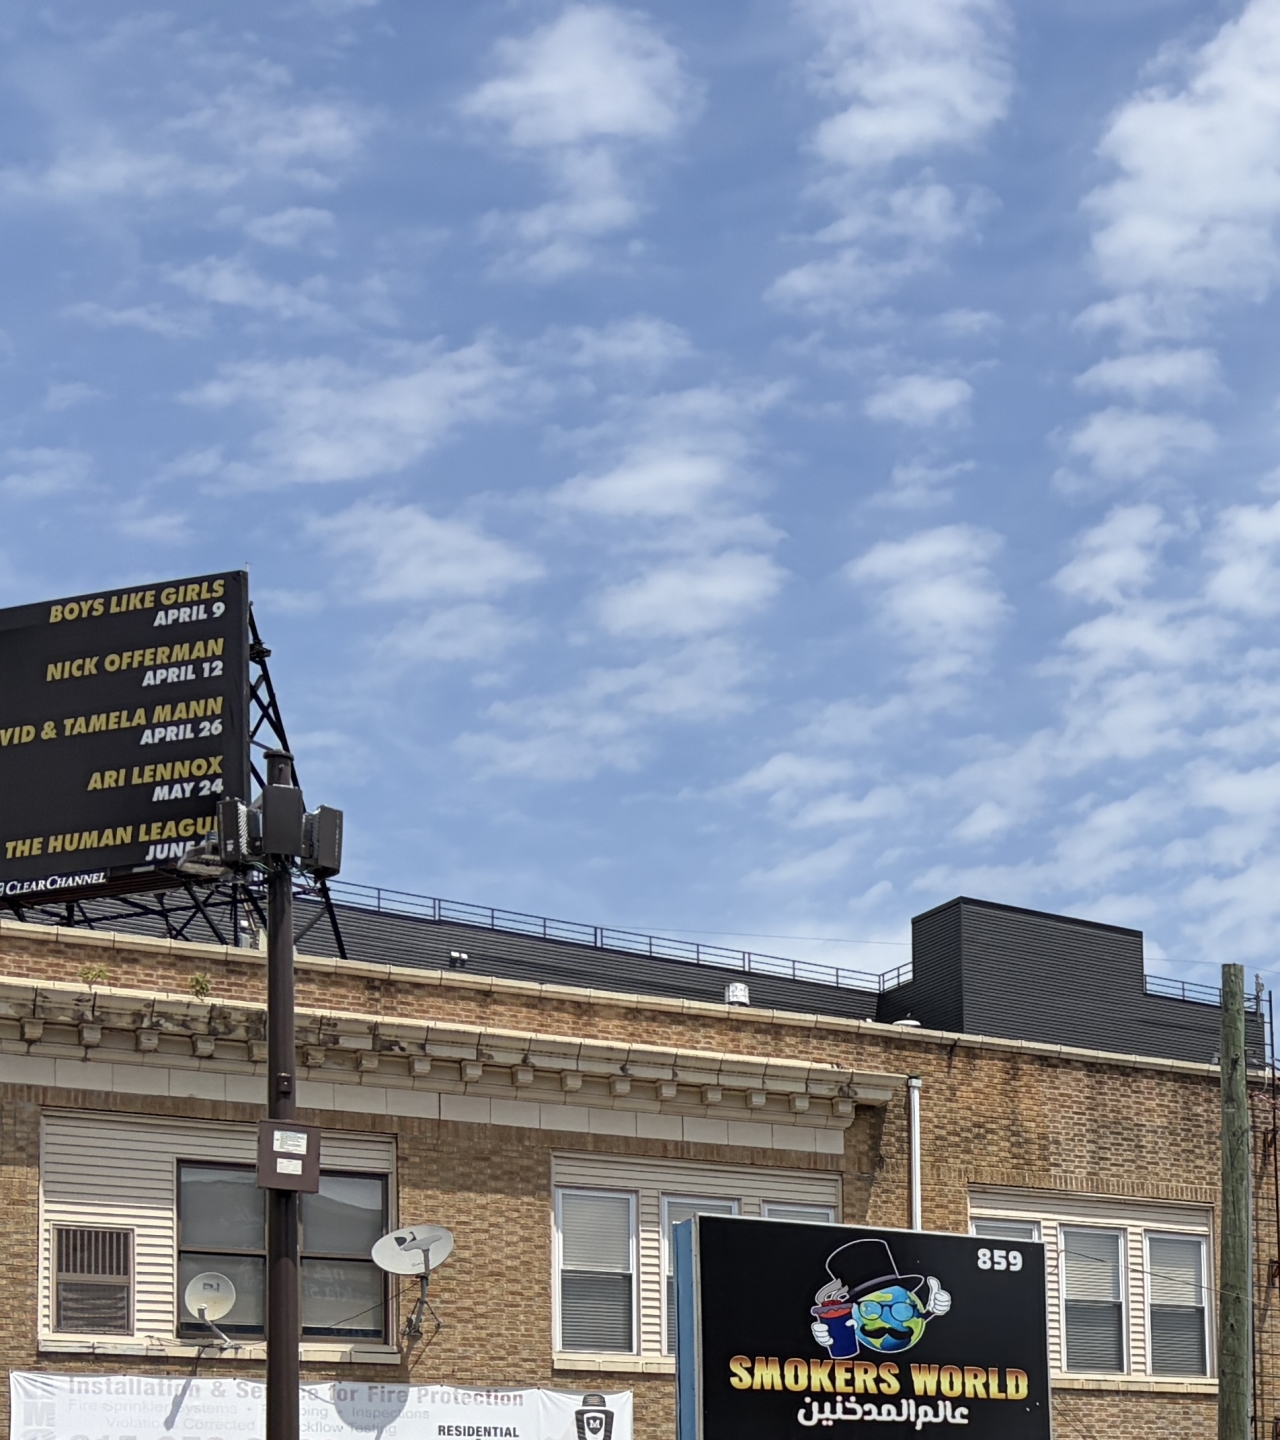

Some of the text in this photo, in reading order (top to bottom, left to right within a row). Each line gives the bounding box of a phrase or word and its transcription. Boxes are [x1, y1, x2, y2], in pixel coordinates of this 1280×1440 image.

[49, 579, 225, 624] BOYS LIKE GIRLS
[153, 602, 225, 627] APRIL 9
[46, 638, 224, 682] NICK OFFERMAN
[142, 660, 223, 687] APRIL 12
[41, 720, 57, 740] &
[63, 708, 147, 735] TAMELA
[152, 697, 223, 723] MANN
[140, 719, 223, 745] APRIL 26
[87, 755, 224, 791] ARI LENNOX
[152, 778, 224, 802] MAY 24
[5, 815, 218, 859] THE HUMAN LEAGU
[977, 1248, 1023, 1271] 859
[210, 1380, 227, 1399] &
[729, 1355, 1029, 1400] SMOKERS WORLD
[329, 1383, 359, 1402] for
[367, 1385, 407, 1403] Fire
[416, 1387, 524, 1406] Protection
[183, 1418, 255, 1430] Corrected
[438, 1425, 520, 1438] RESIDENTIAL
